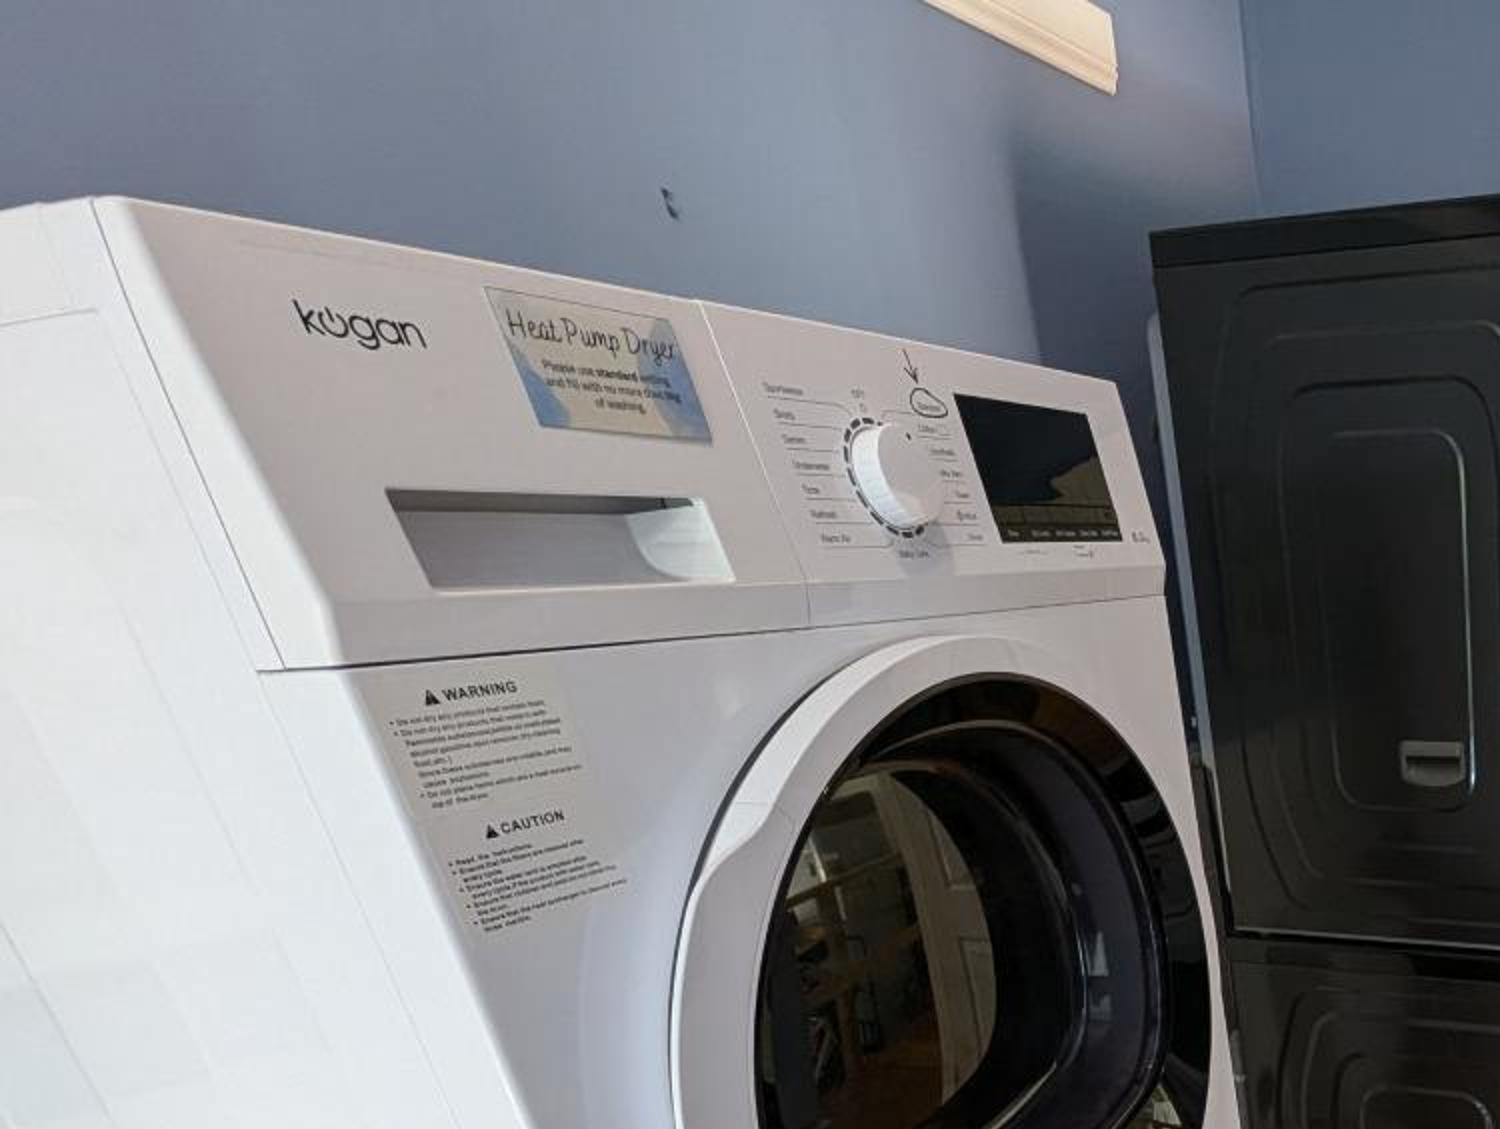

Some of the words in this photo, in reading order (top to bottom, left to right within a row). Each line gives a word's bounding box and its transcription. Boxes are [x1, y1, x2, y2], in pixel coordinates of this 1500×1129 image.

[292, 299, 427, 350] kogan
[505, 308, 562, 343] Heat
[560, 317, 621, 358] Pump
[621, 327, 674, 367] Dryer
[442, 680, 518, 701] WARNING
[500, 810, 565, 834] CAUTION
